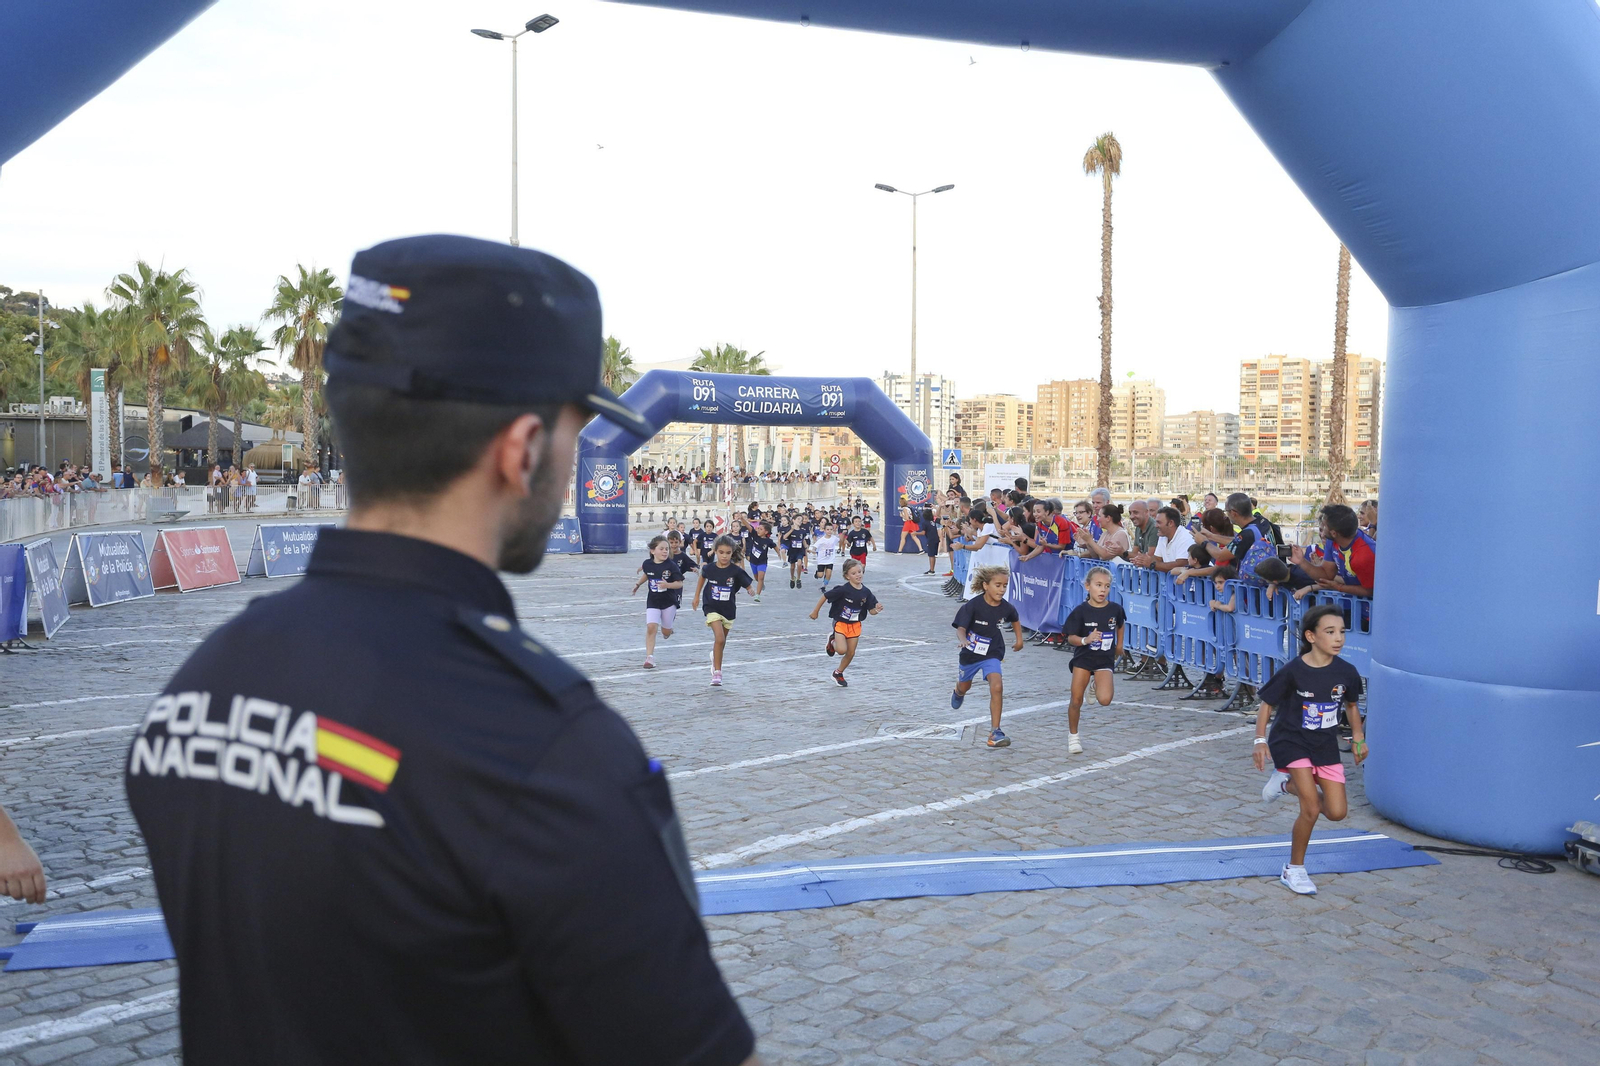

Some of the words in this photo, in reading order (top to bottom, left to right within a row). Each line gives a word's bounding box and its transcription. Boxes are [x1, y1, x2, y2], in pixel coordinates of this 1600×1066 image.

[692, 378, 715, 387] RUTA
[820, 384, 843, 392] RUTA
[693, 386, 716, 402] 091
[738, 385, 800, 400] CARRERA
[821, 392, 843, 407] 091
[734, 401, 803, 415] SOLIDARIA
[595, 463, 617, 471] mupol
[282, 531, 318, 542] Mutualidad
[98, 542, 130, 557] Mutualidad
[200, 545, 221, 554] Santander
[283, 544, 292, 555] de
[292, 543, 300, 554] la
[101, 561, 110, 575] de
[108, 560, 116, 574] la
[139, 691, 317, 763] POLICIA
